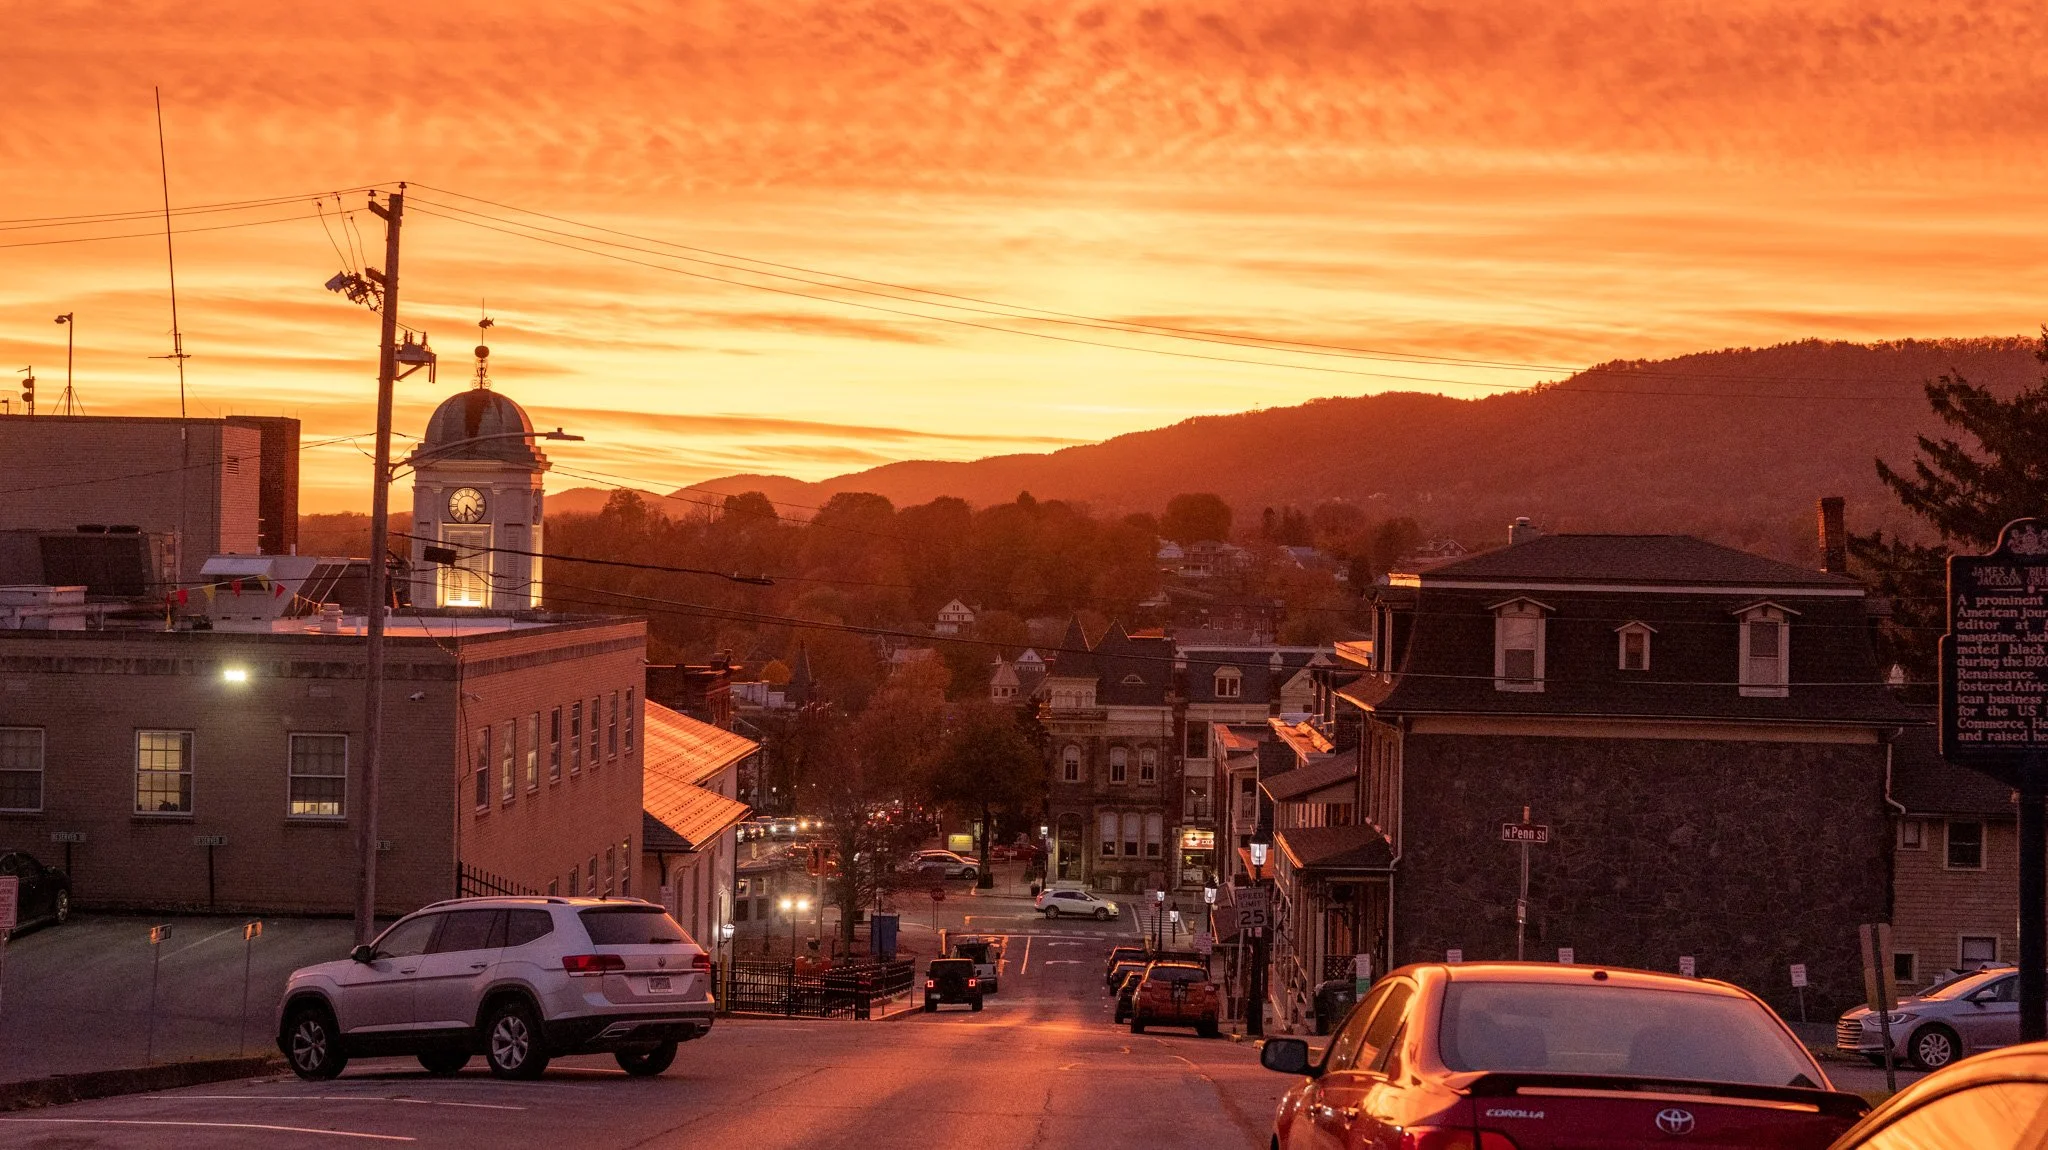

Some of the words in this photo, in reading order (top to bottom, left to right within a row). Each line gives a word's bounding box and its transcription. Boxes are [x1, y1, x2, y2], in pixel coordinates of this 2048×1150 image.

[1971, 566, 2006, 577] JAMES
[1977, 576, 2022, 586] JACKSON
[1957, 594, 1967, 606] A
[1975, 595, 2044, 608] prominent
[1957, 605, 2018, 618] American
[1957, 619, 2000, 630] editor
[2015, 620, 2030, 630] at
[1957, 632, 2020, 644] magazine.
[1957, 643, 1999, 655] moted
[2008, 643, 2045, 655] black
[1957, 656, 2000, 669] during
[2001, 656, 2023, 667] the
[1957, 668, 2039, 680] Renaissance.
[1957, 680, 2012, 692] fostered
[2014, 681, 2048, 692] Afric
[1957, 693, 1985, 704] ican
[1988, 693, 2042, 704] business
[1957, 705, 1978, 716] for
[1986, 705, 2009, 716] the
[2017, 705, 2037, 717] US
[1957, 717, 2028, 729] Commerce.
[1957, 730, 1982, 741] and
[1987, 730, 2028, 741] raised
[1505, 829, 1510, 838] N
[1511, 827, 1534, 839] Penn
[1537, 830, 1545, 840] St
[1237, 892, 1264, 900] SPEED
[1240, 900, 1261, 908] LIMIT
[1240, 909, 1265, 925] 25
[1486, 1109, 1545, 1119] COROLLA
